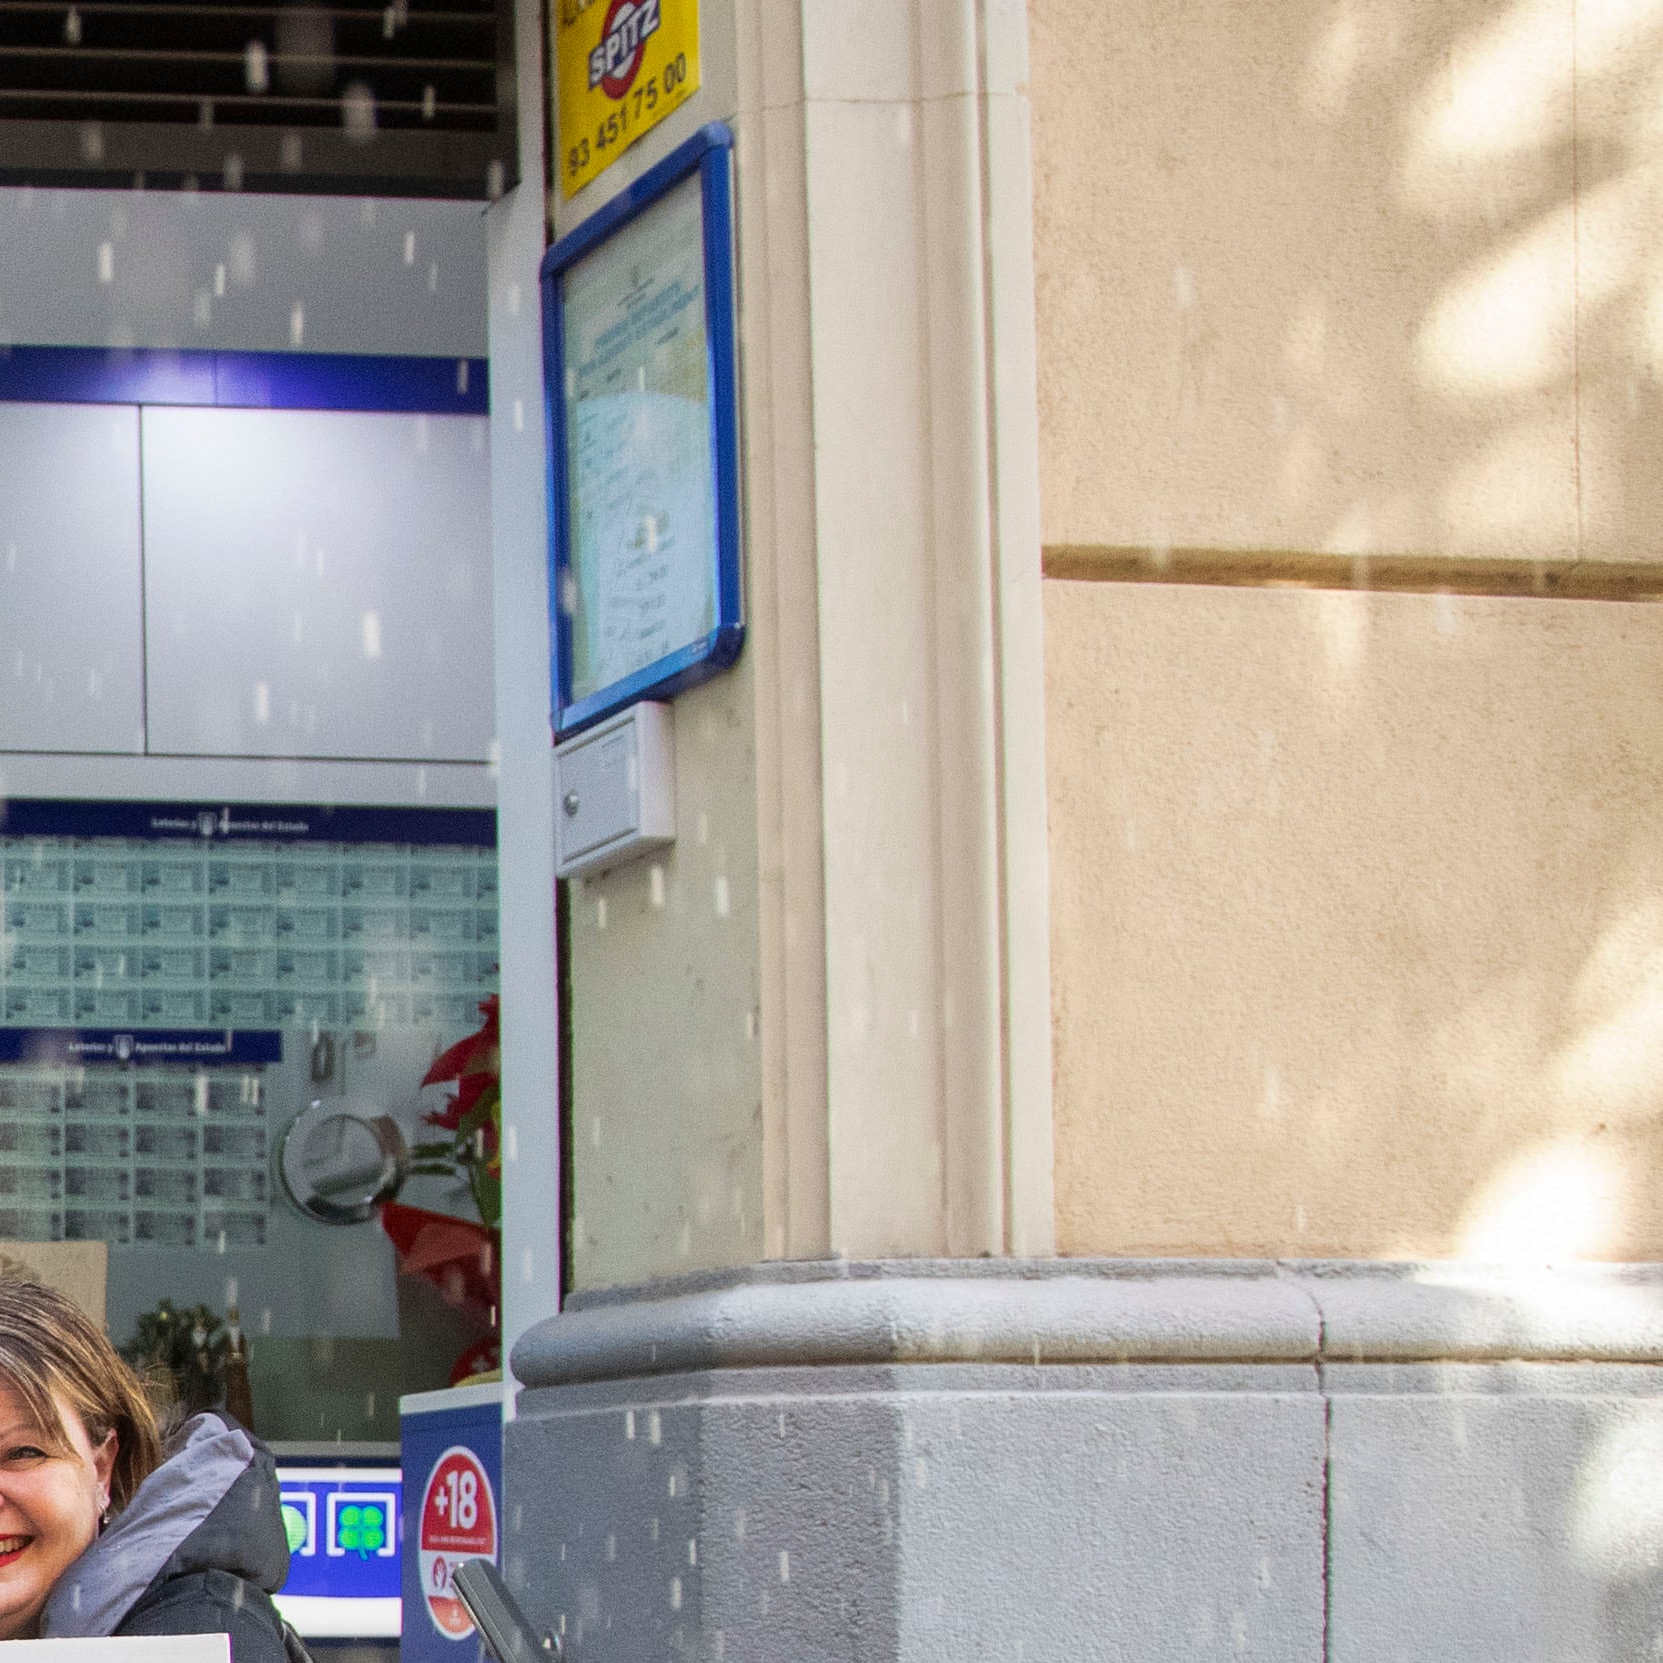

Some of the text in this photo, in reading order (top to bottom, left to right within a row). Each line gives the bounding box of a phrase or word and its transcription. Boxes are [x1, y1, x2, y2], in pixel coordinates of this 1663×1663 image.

[591, 0, 659, 84] SPITZ
[568, 137, 590, 177] 93
[595, 103, 627, 150] 451
[633, 76, 658, 119] 75
[663, 51, 686, 95] 00
[433, 1470, 477, 1530] +18
